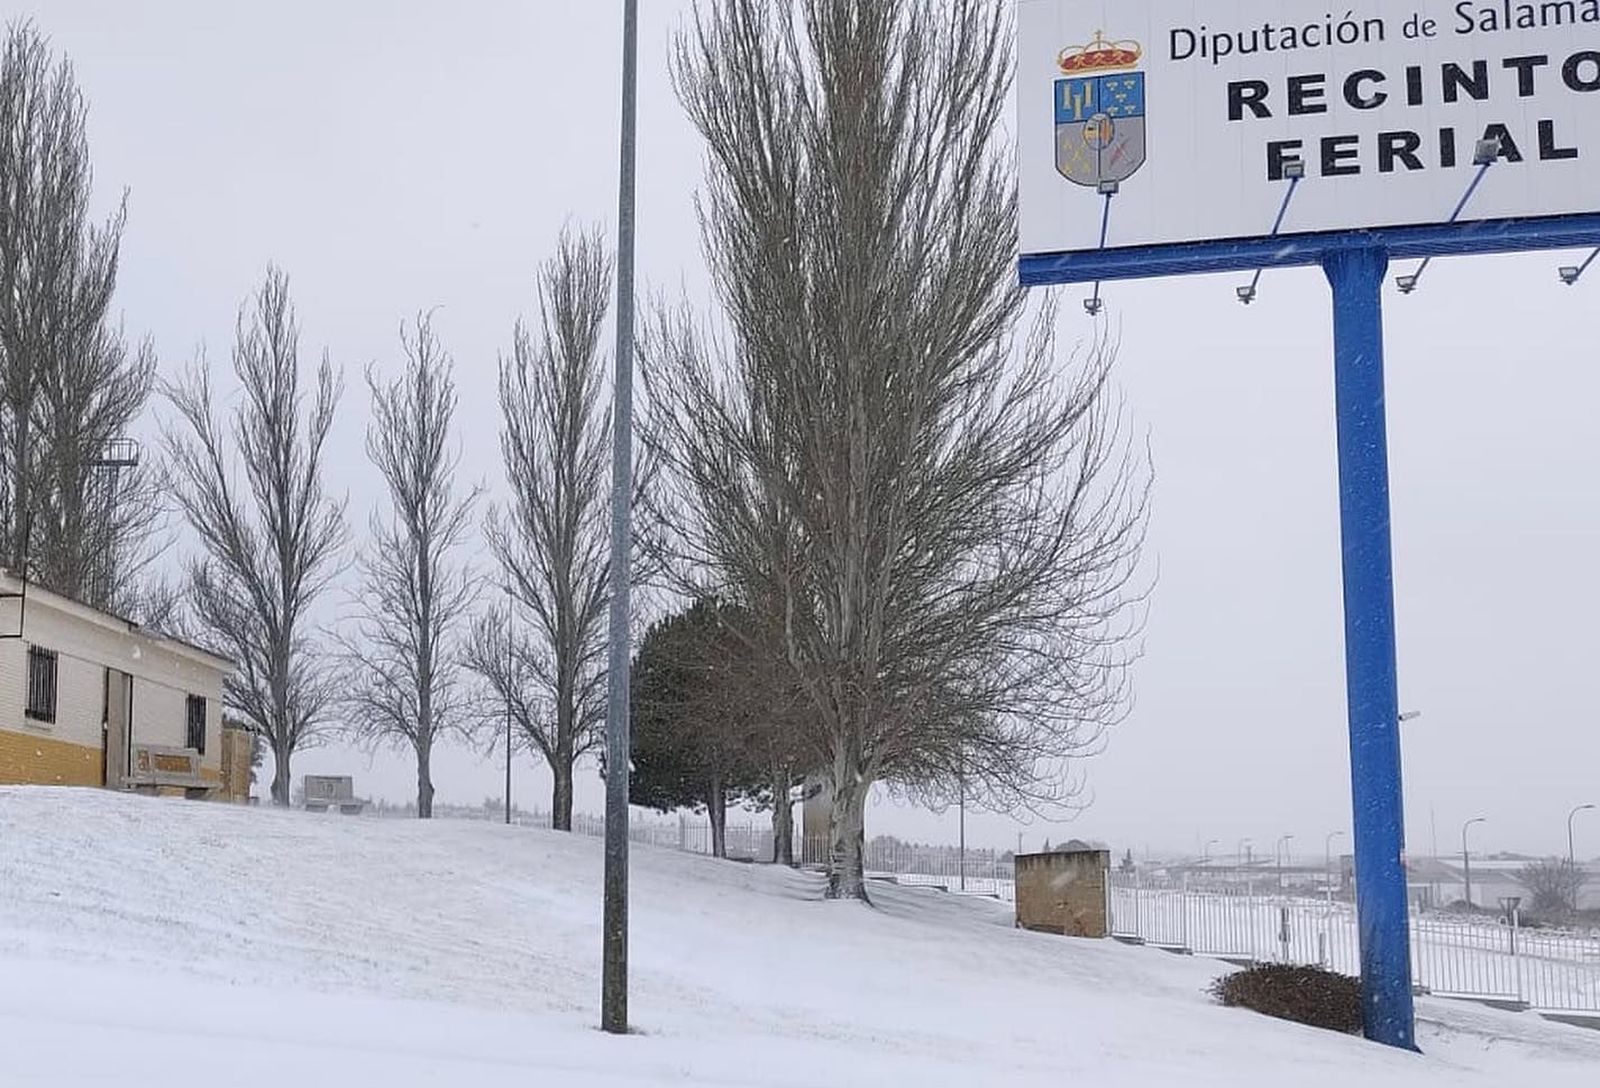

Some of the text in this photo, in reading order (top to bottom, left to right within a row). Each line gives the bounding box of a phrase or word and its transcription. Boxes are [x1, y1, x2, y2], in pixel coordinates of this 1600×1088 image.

[1169, 10, 1386, 65] Diputación
[1402, 12, 1438, 39] de
[1226, 50, 1600, 122] RECINTO
[1266, 119, 1579, 182] FERIAL
